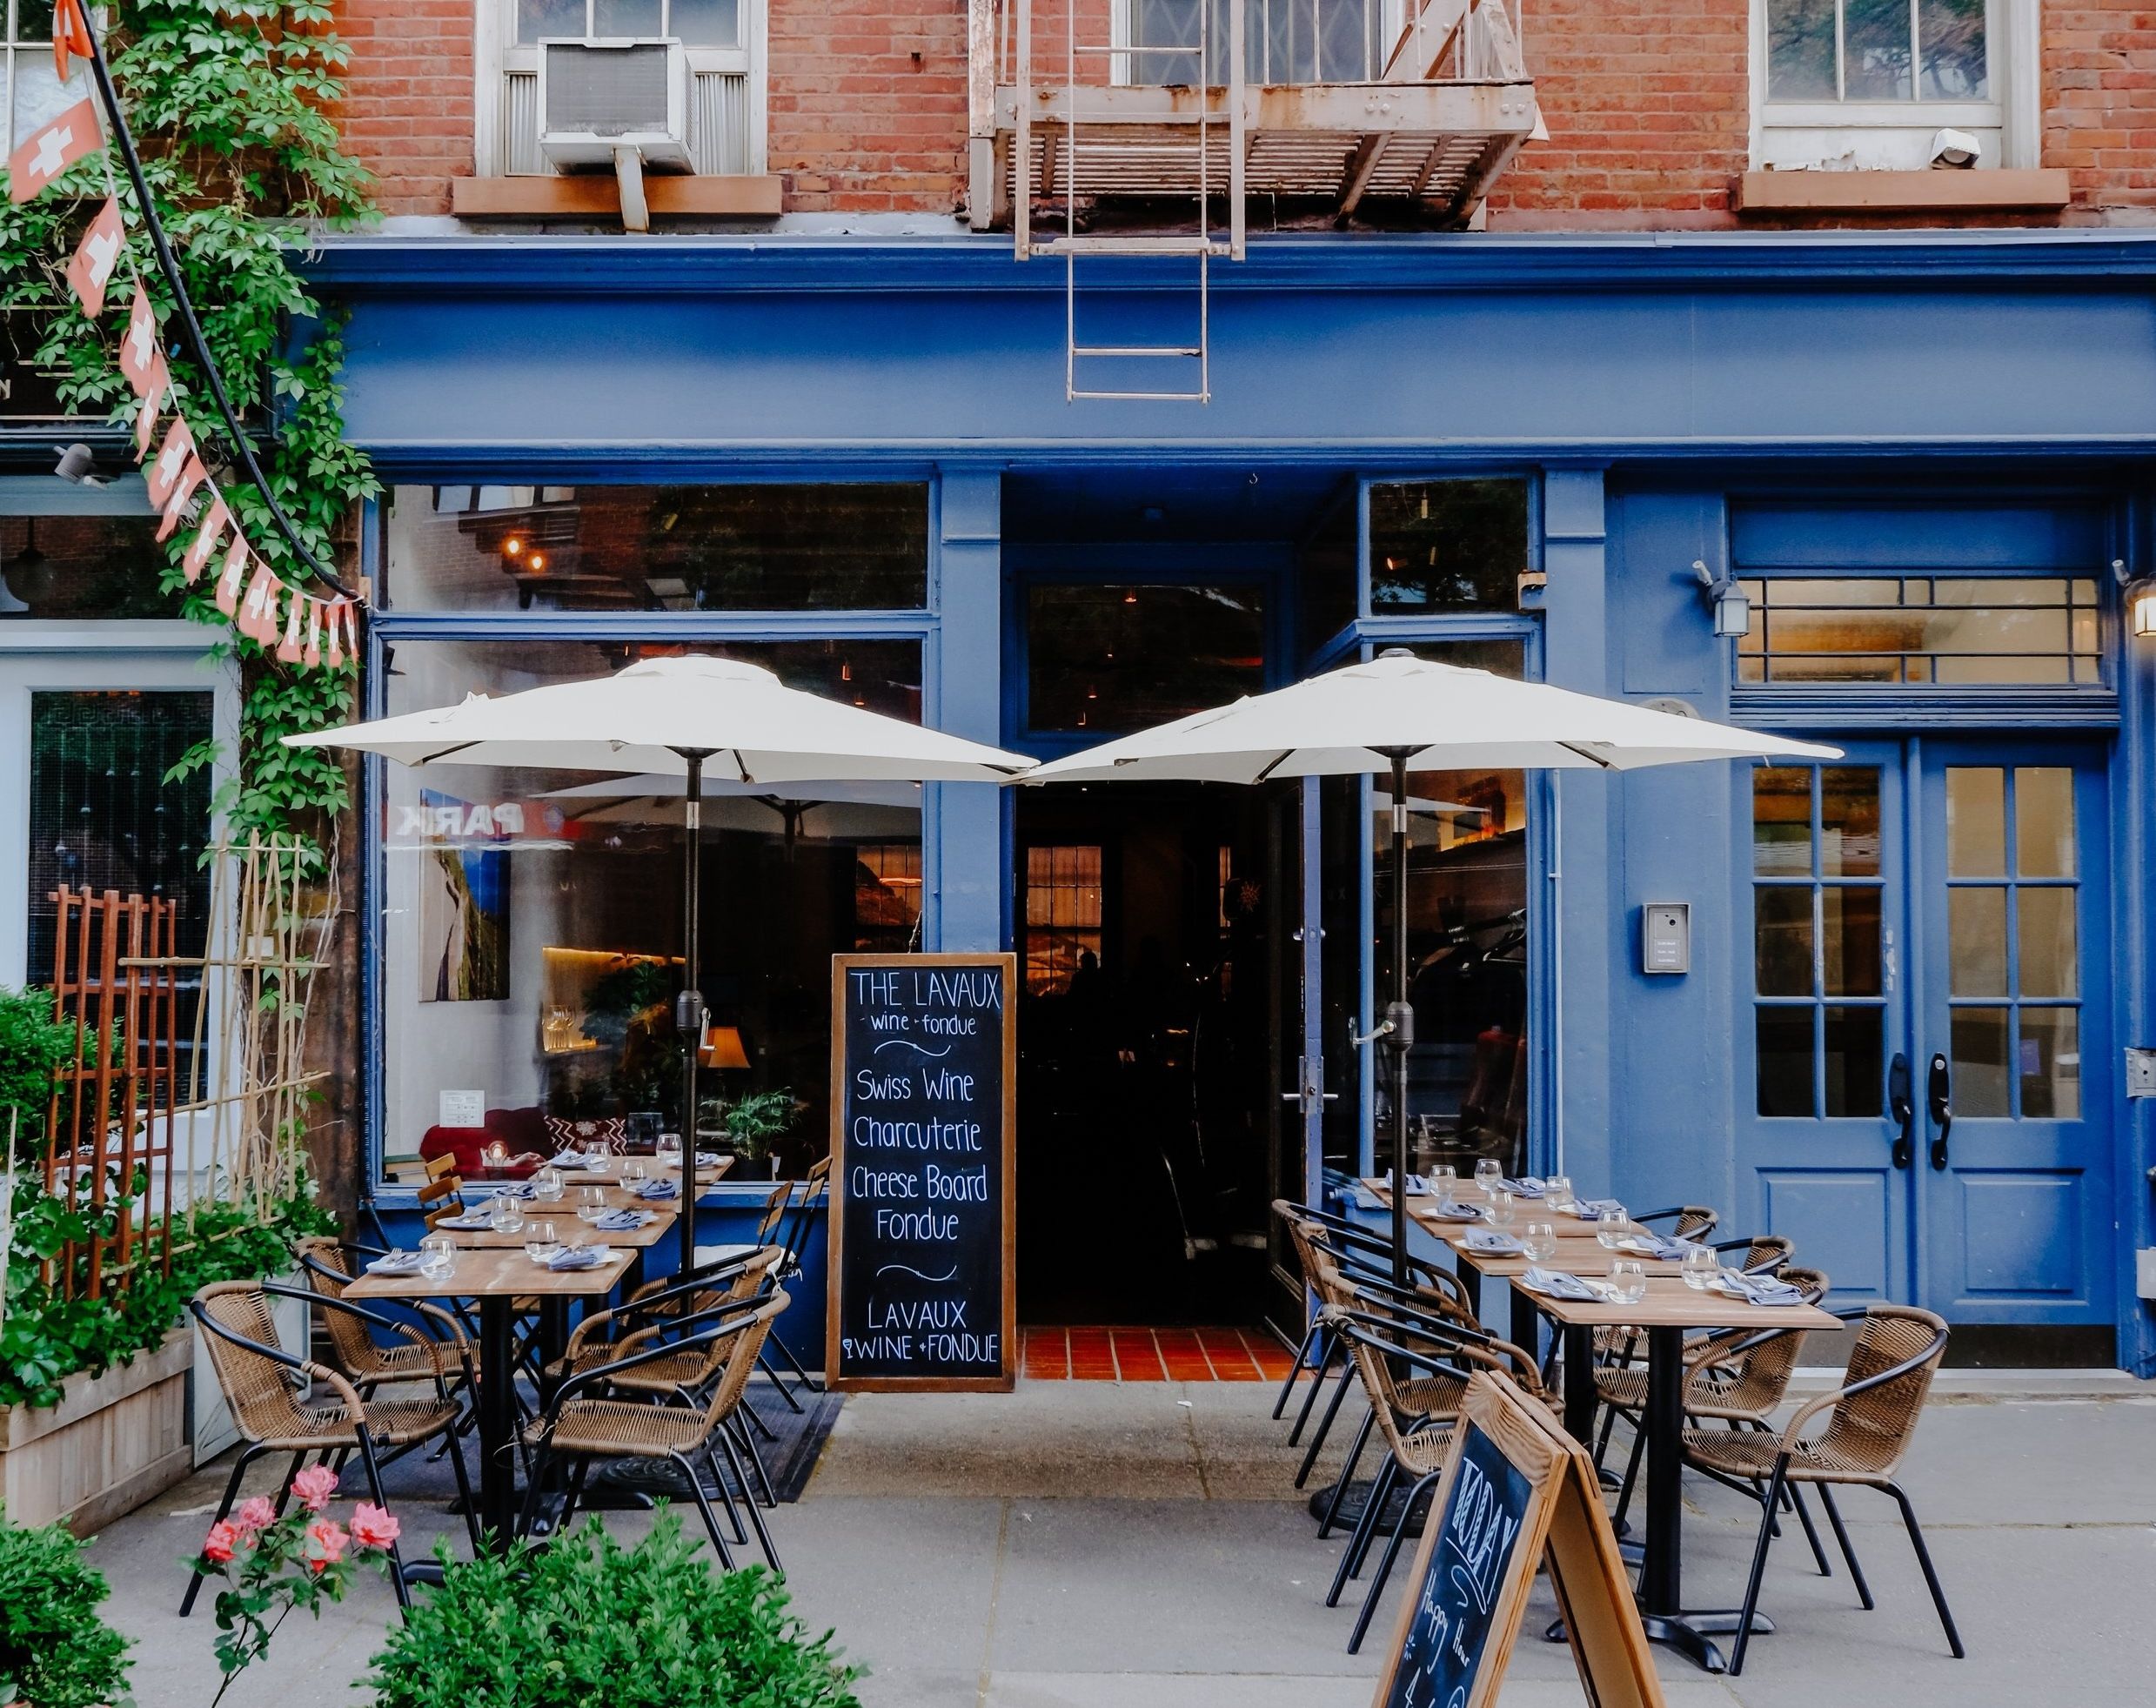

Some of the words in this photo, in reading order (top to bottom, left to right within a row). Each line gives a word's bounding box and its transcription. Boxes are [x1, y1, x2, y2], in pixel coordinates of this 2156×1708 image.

[850, 972, 902, 1006] THE
[914, 972, 1001, 1009] LAVAUX
[870, 1011, 909, 1030] wine
[922, 1014, 977, 1035] fondue
[857, 1069, 912, 1101] Swiss
[922, 1068, 974, 1102] Wine
[854, 1116, 982, 1151] Charcuterie
[853, 1166, 919, 1198] Cheese
[927, 1164, 988, 1202] Board
[877, 1206, 959, 1241] Fondue
[868, 1301, 967, 1329] LAVAUX
[854, 1336, 913, 1360] WINE
[928, 1334, 998, 1363] FONDUE
[1451, 1457, 1519, 1605] TODAY
[1421, 1568, 1449, 1675] Happy
[1452, 1617, 1470, 1668] Hour
